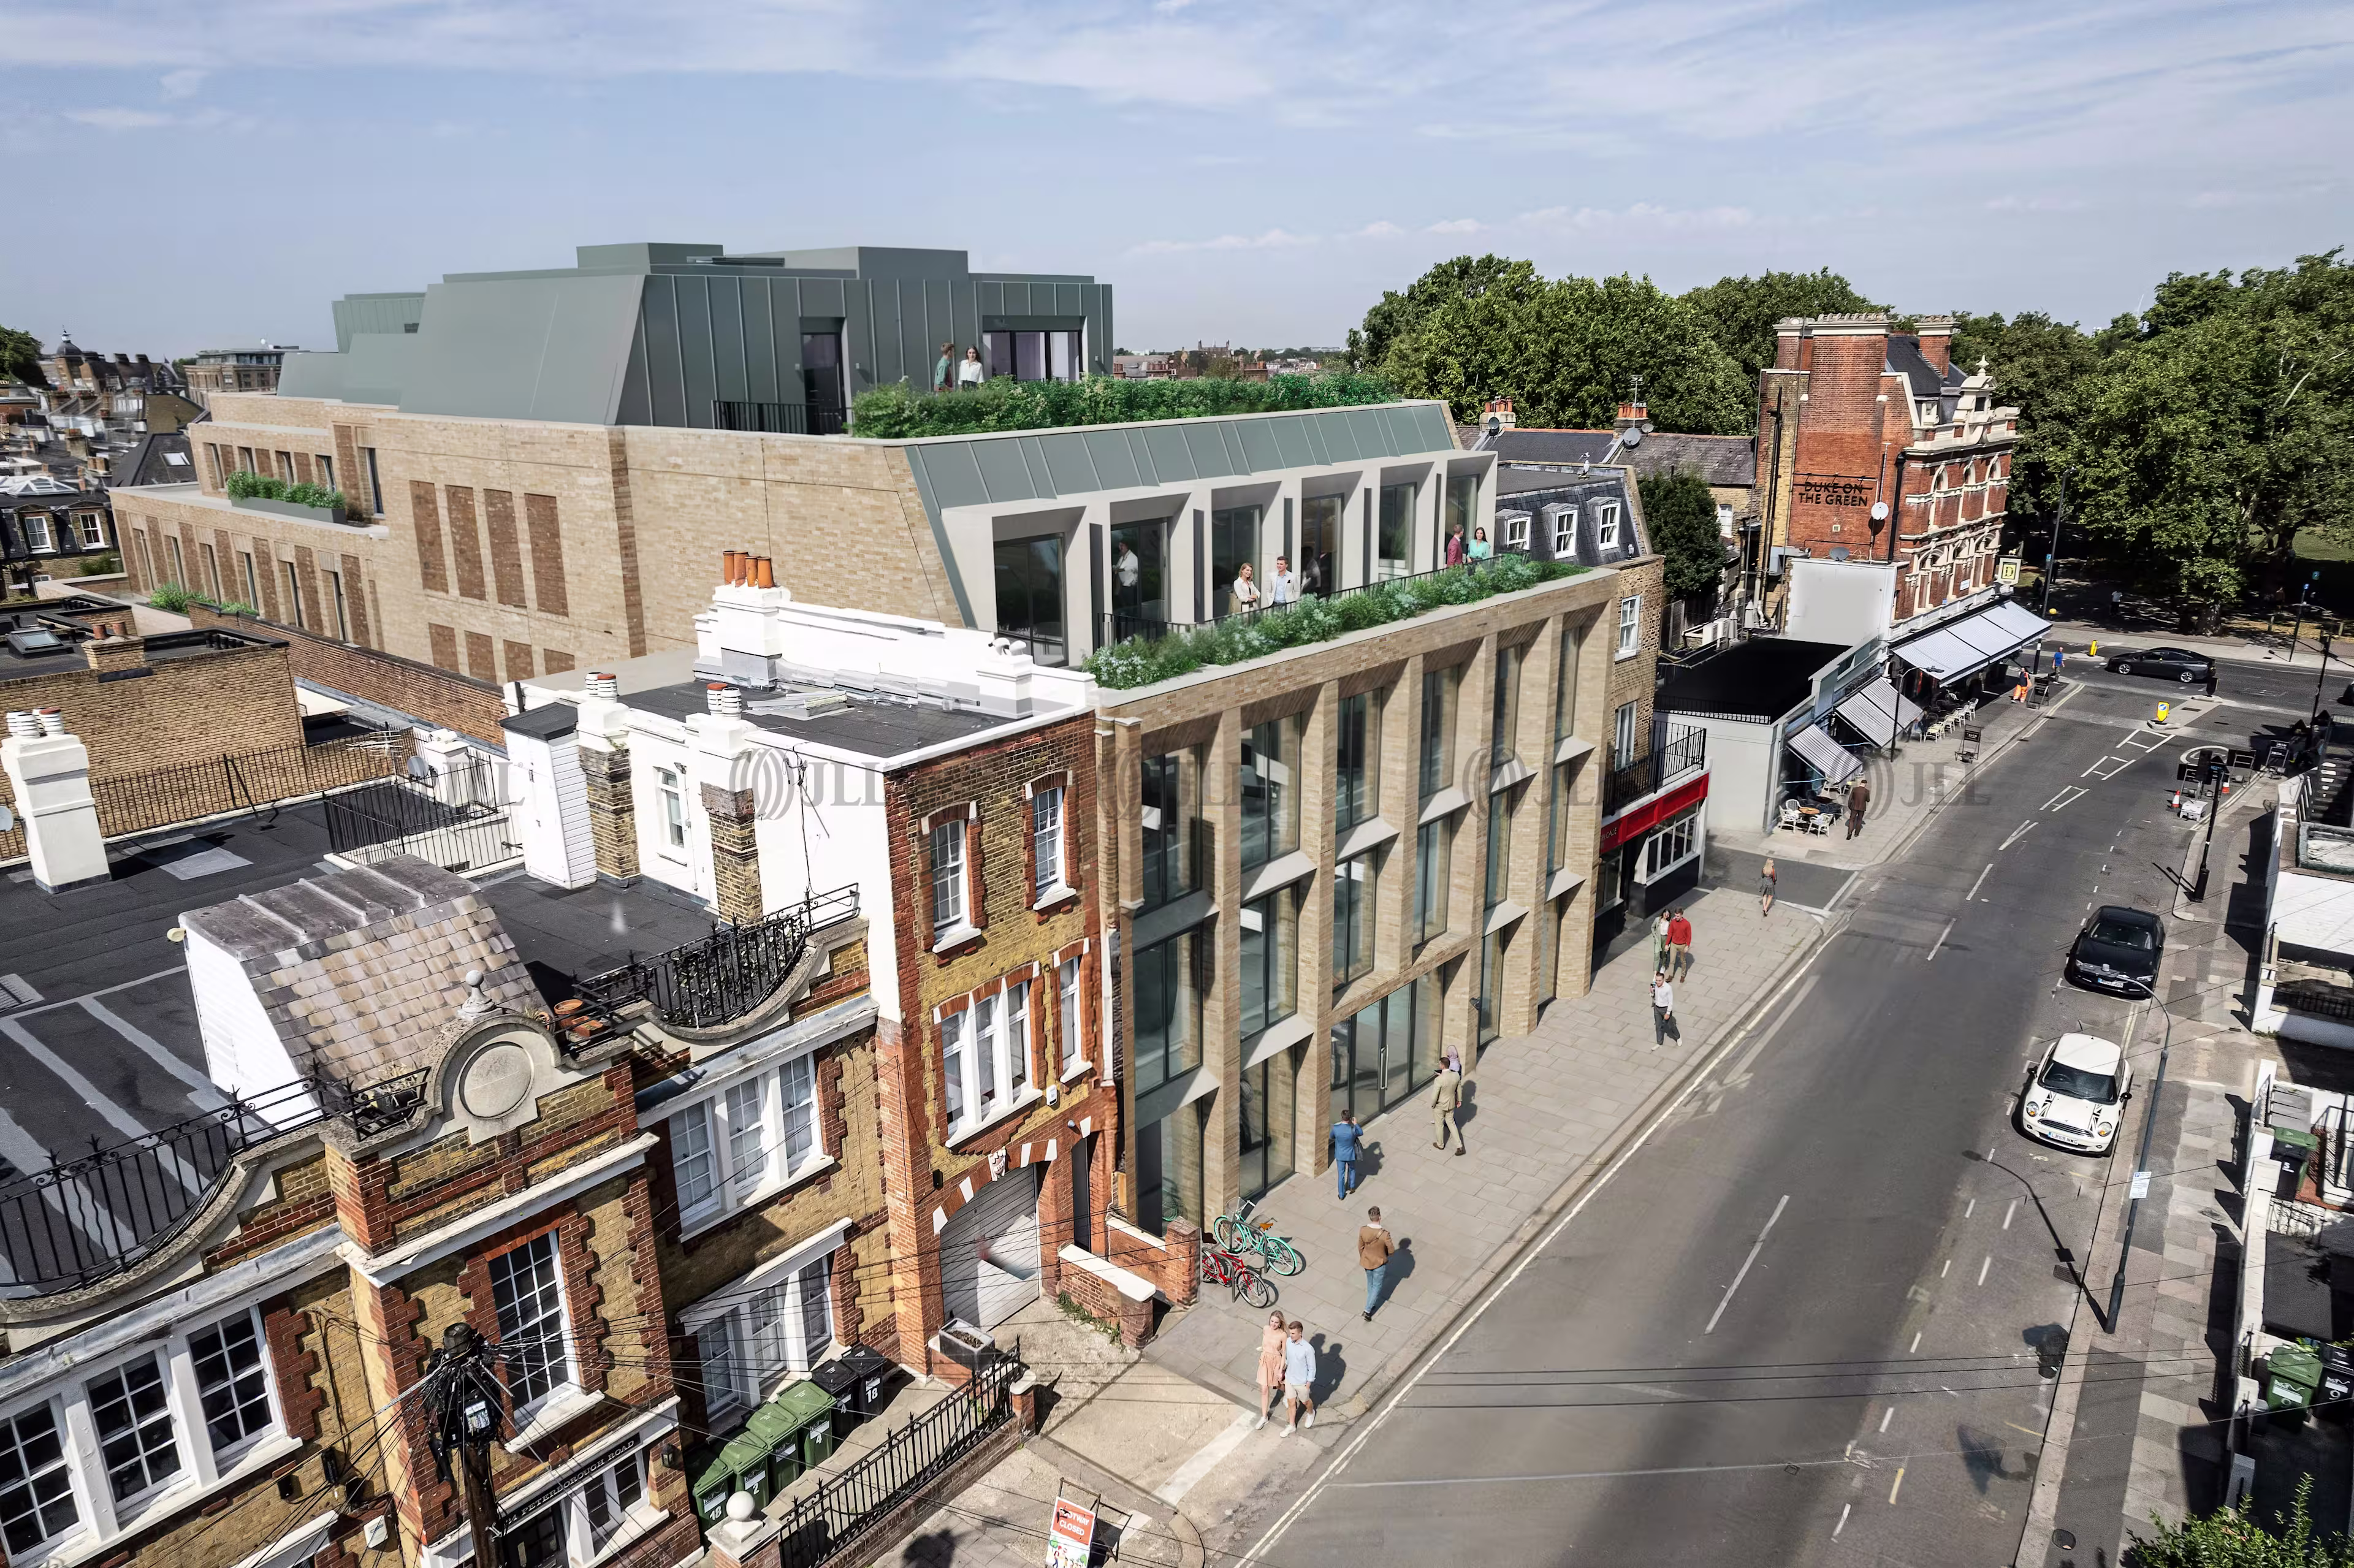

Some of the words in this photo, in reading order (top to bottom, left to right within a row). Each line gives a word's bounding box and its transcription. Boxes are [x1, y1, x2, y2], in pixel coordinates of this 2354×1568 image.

[1804, 481, 1838, 494] DUKE
[1843, 483, 1863, 495] ON
[1799, 493, 1821, 504] THE
[1825, 494, 1868, 506] GREEN
[2004, 566, 2014, 577] D
[866, 1387, 878, 1403] 18
[2329, 1390, 2341, 1400] 9
[816, 1432, 822, 1444] 4
[521, 1458, 606, 1516] PETERBOROUGH
[608, 1440, 634, 1461] ROAD
[752, 1482, 760, 1495] 2
[709, 1505, 722, 1520] 18
[1059, 1520, 1084, 1536] CLOSED
